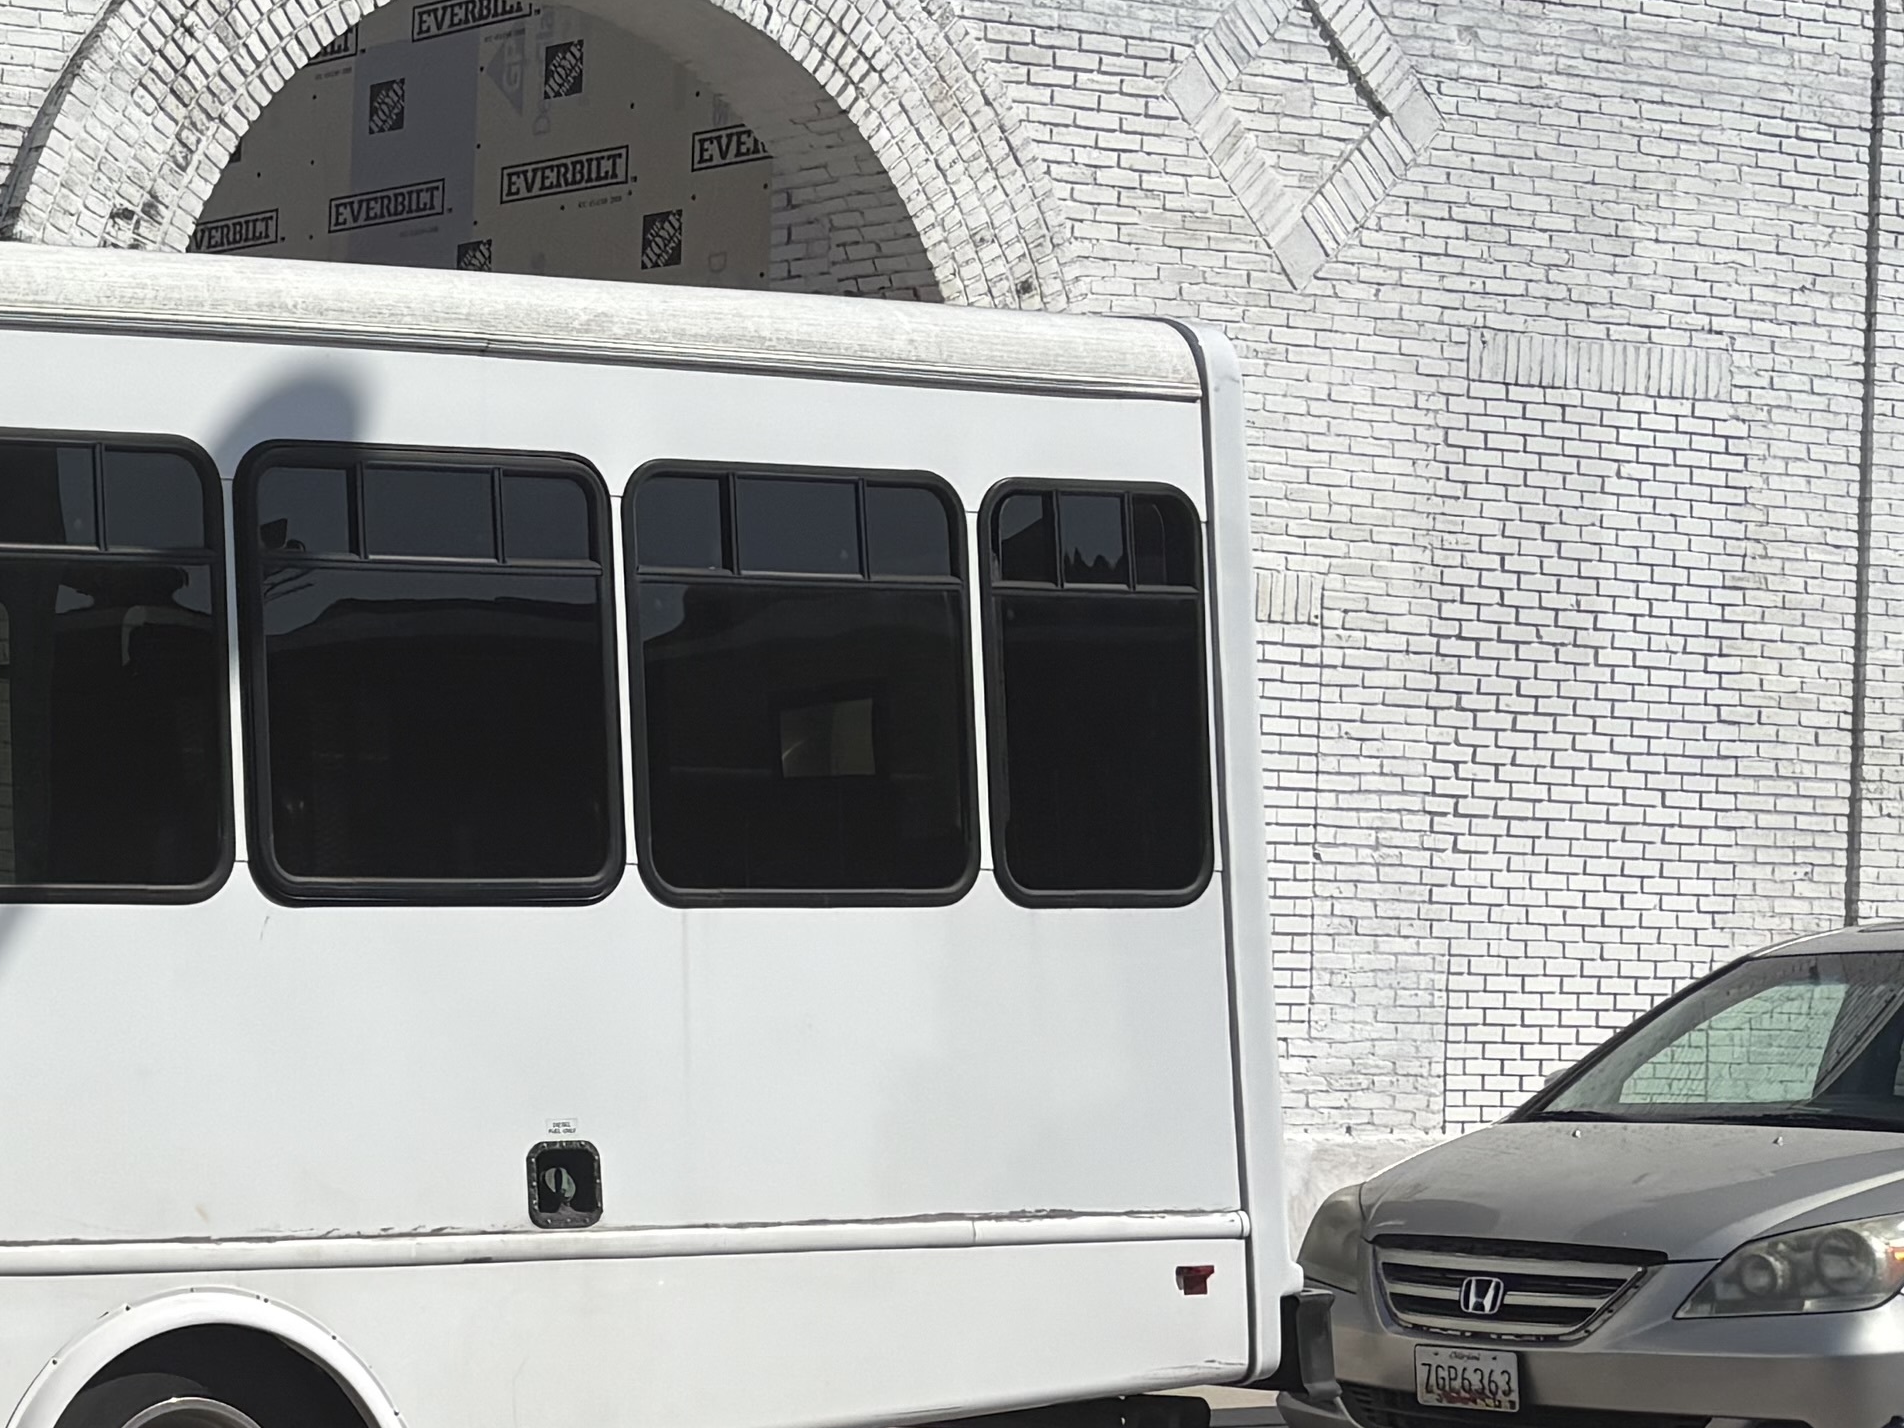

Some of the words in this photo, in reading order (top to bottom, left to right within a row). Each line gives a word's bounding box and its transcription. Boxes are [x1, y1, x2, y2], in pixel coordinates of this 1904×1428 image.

[545, 41, 583, 98] HOME
[370, 79, 404, 132] HOME
[505, 152, 622, 197] EVERBILT
[334, 185, 440, 227] EVERBILT
[192, 215, 274, 251] VERBILT
[642, 211, 682, 268] HOME
